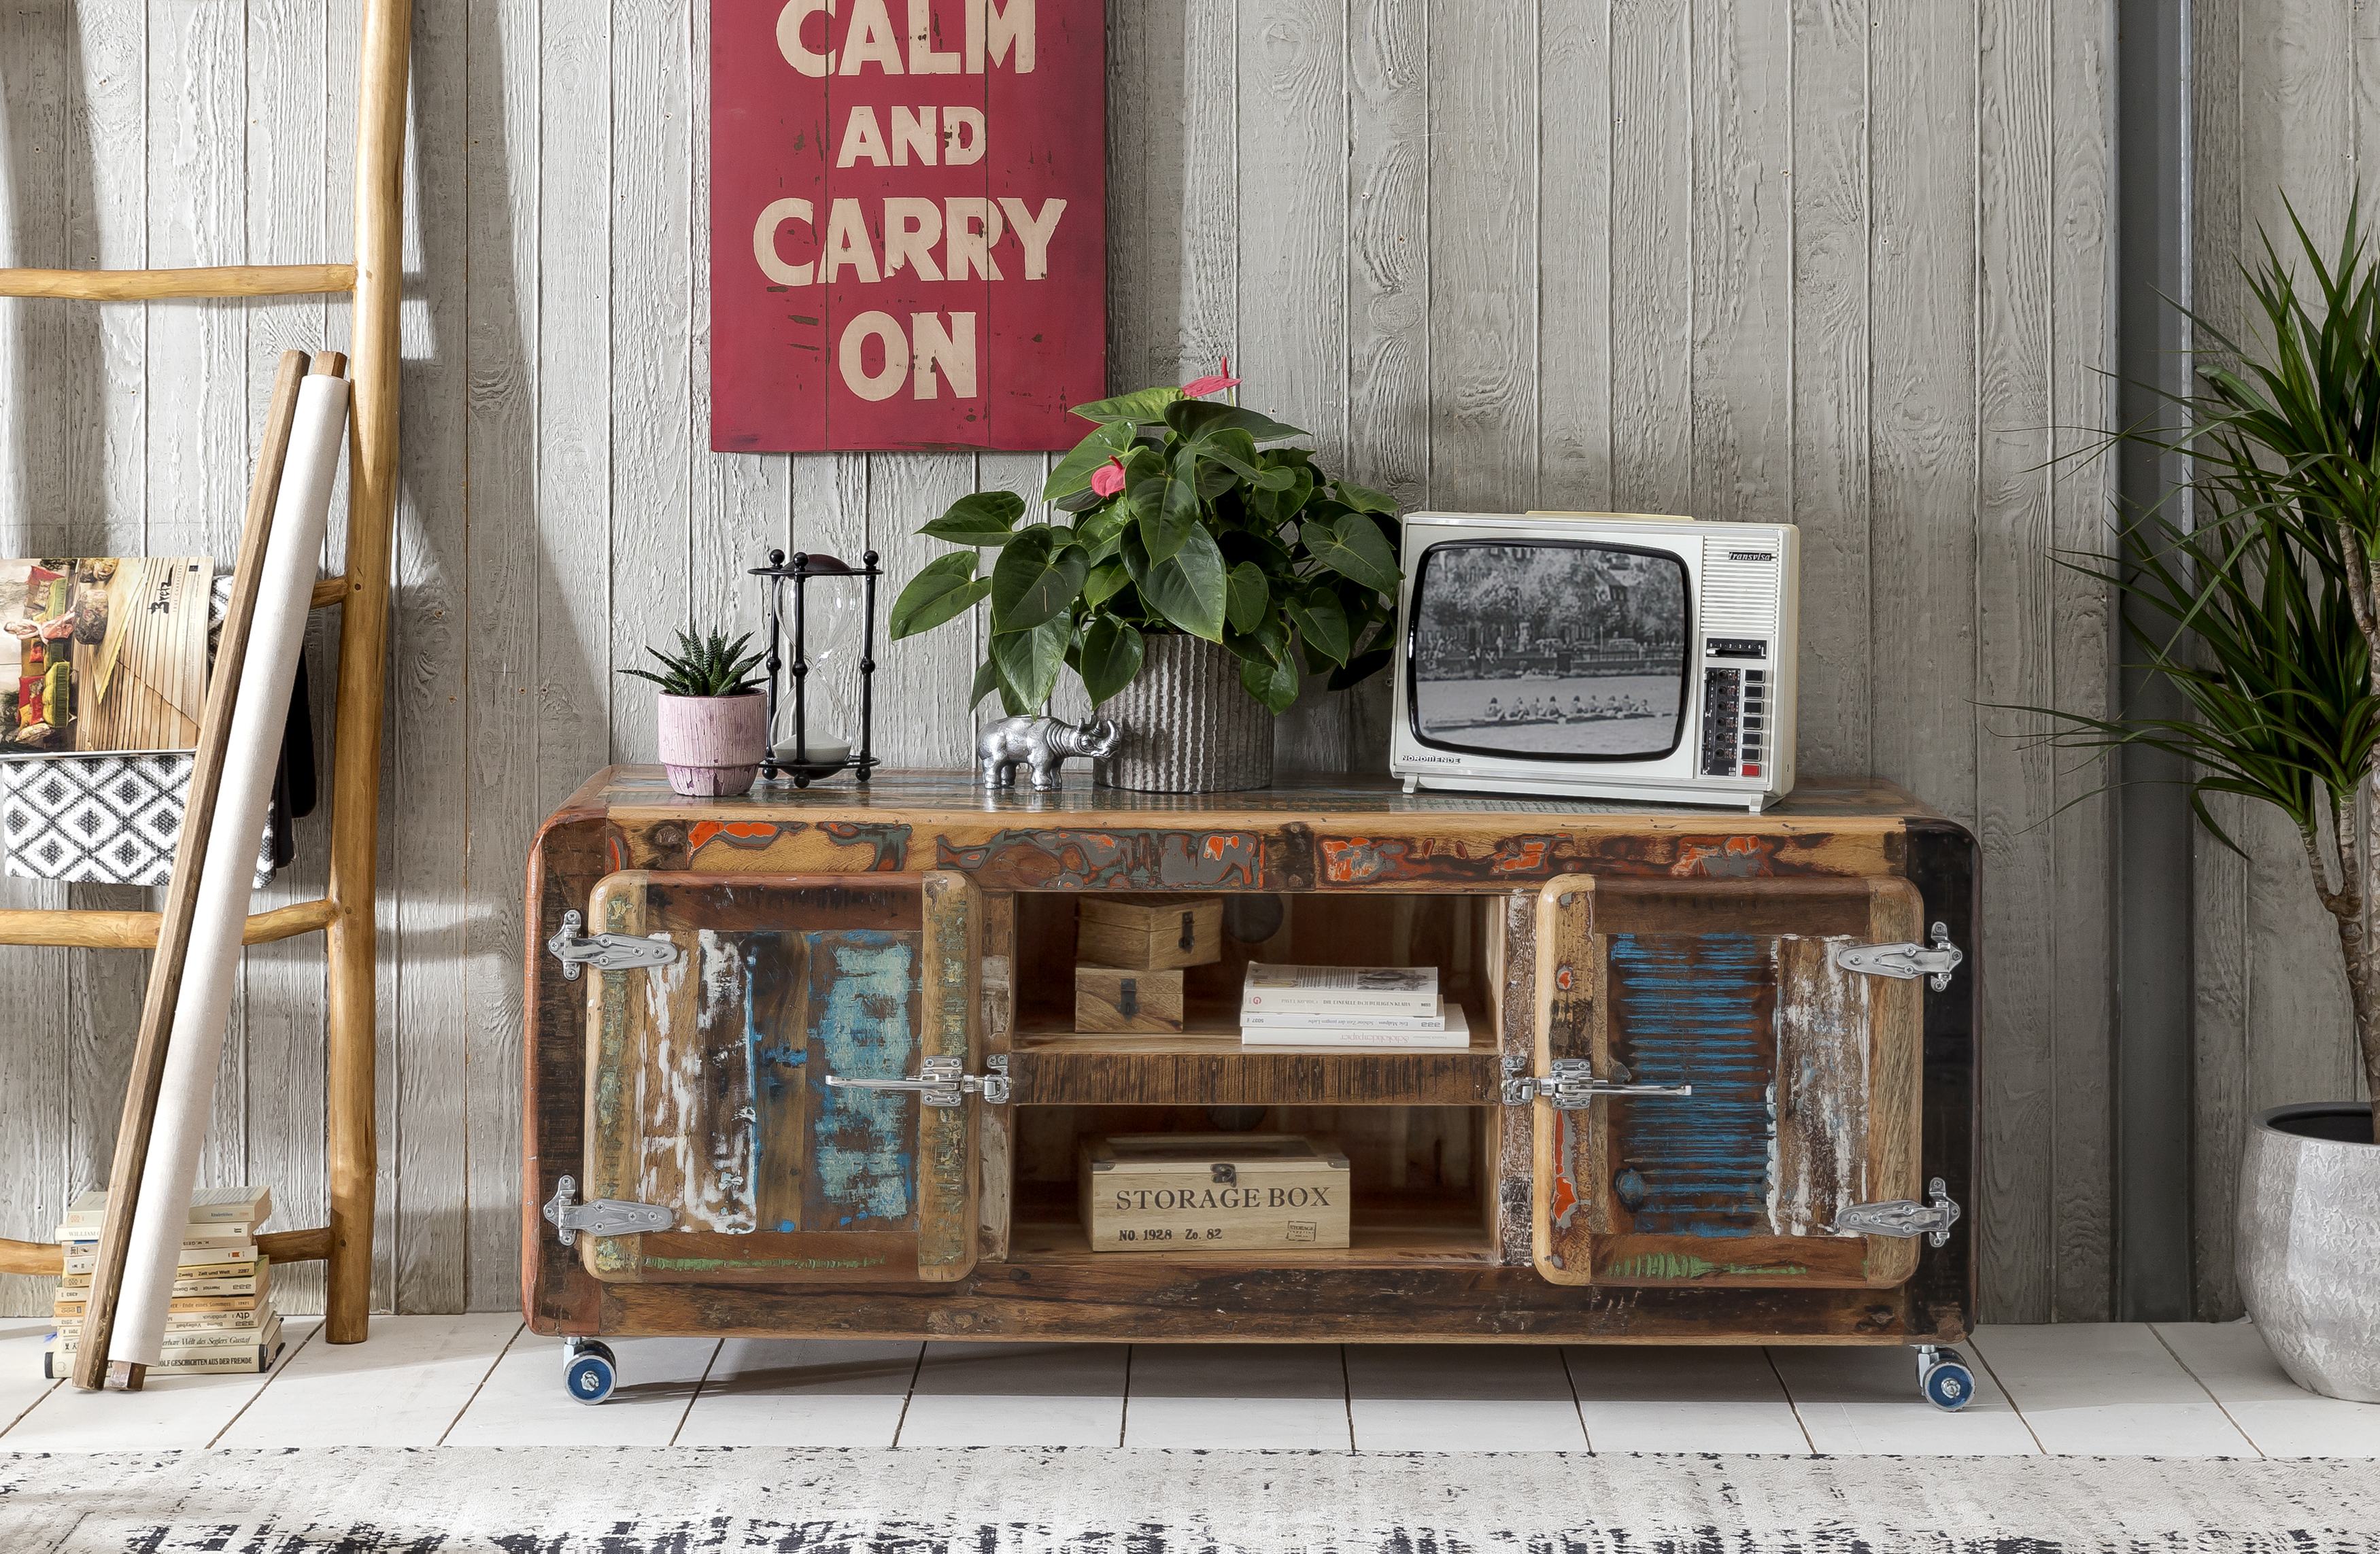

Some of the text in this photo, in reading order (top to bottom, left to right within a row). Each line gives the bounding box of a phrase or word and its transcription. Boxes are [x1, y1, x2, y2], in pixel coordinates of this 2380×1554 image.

[776, 0, 1036, 77] CALM
[836, 106, 986, 168] AND
[753, 197, 1068, 286] CARRY
[839, 311, 977, 401] ON
[147, 564, 175, 615] Bretz
[1401, 755, 1461, 763] NORDMENDE
[1117, 1187, 1331, 1210] STORAGE BOX
[1119, 1229, 1138, 1241] NO.
[1143, 1229, 1172, 1241] 1928
[1206, 1228, 1223, 1239] 82
[209, 1358, 219, 1366] AUS
